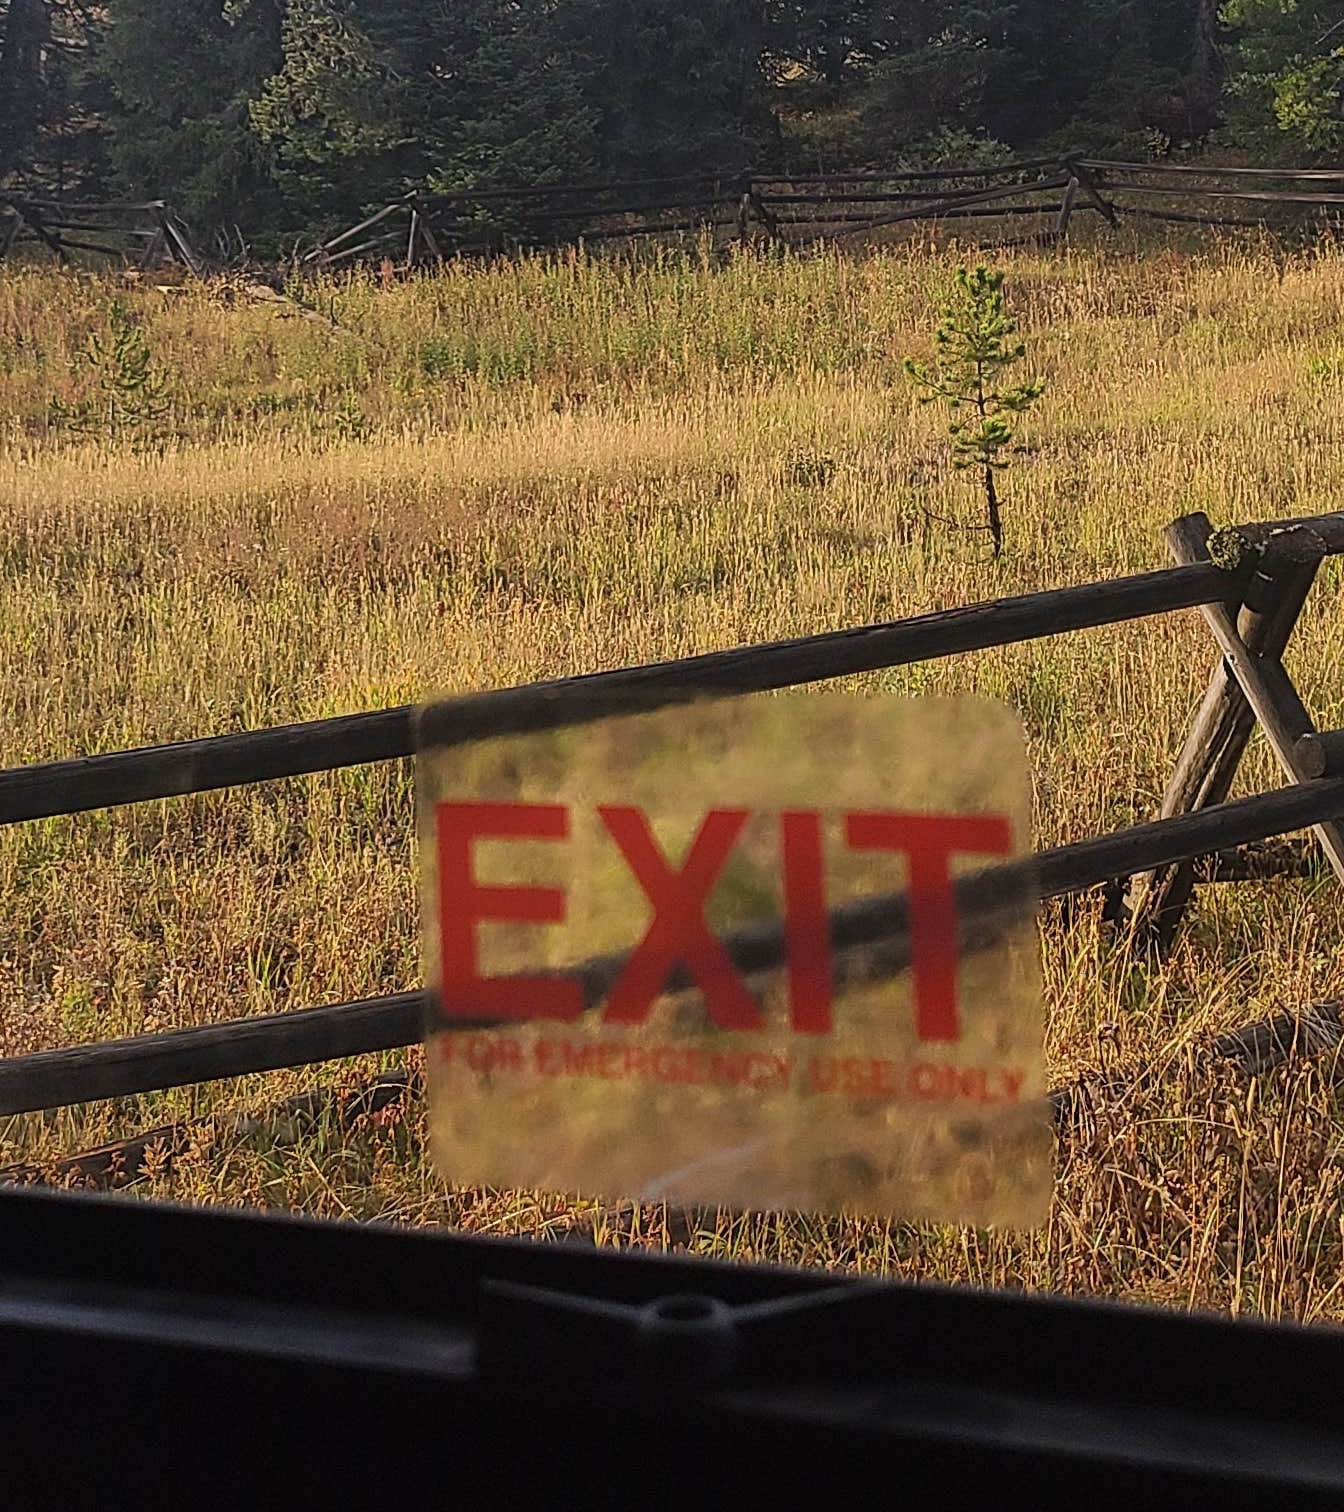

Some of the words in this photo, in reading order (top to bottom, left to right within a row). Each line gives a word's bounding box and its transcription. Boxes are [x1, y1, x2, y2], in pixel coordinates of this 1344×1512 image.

[433, 800, 1012, 1043] EXIT
[440, 1034, 523, 1071] FOR
[534, 1040, 792, 1089] EMERGENCY
[810, 1055, 894, 1096] USE
[910, 1062, 1025, 1103] ONLY
